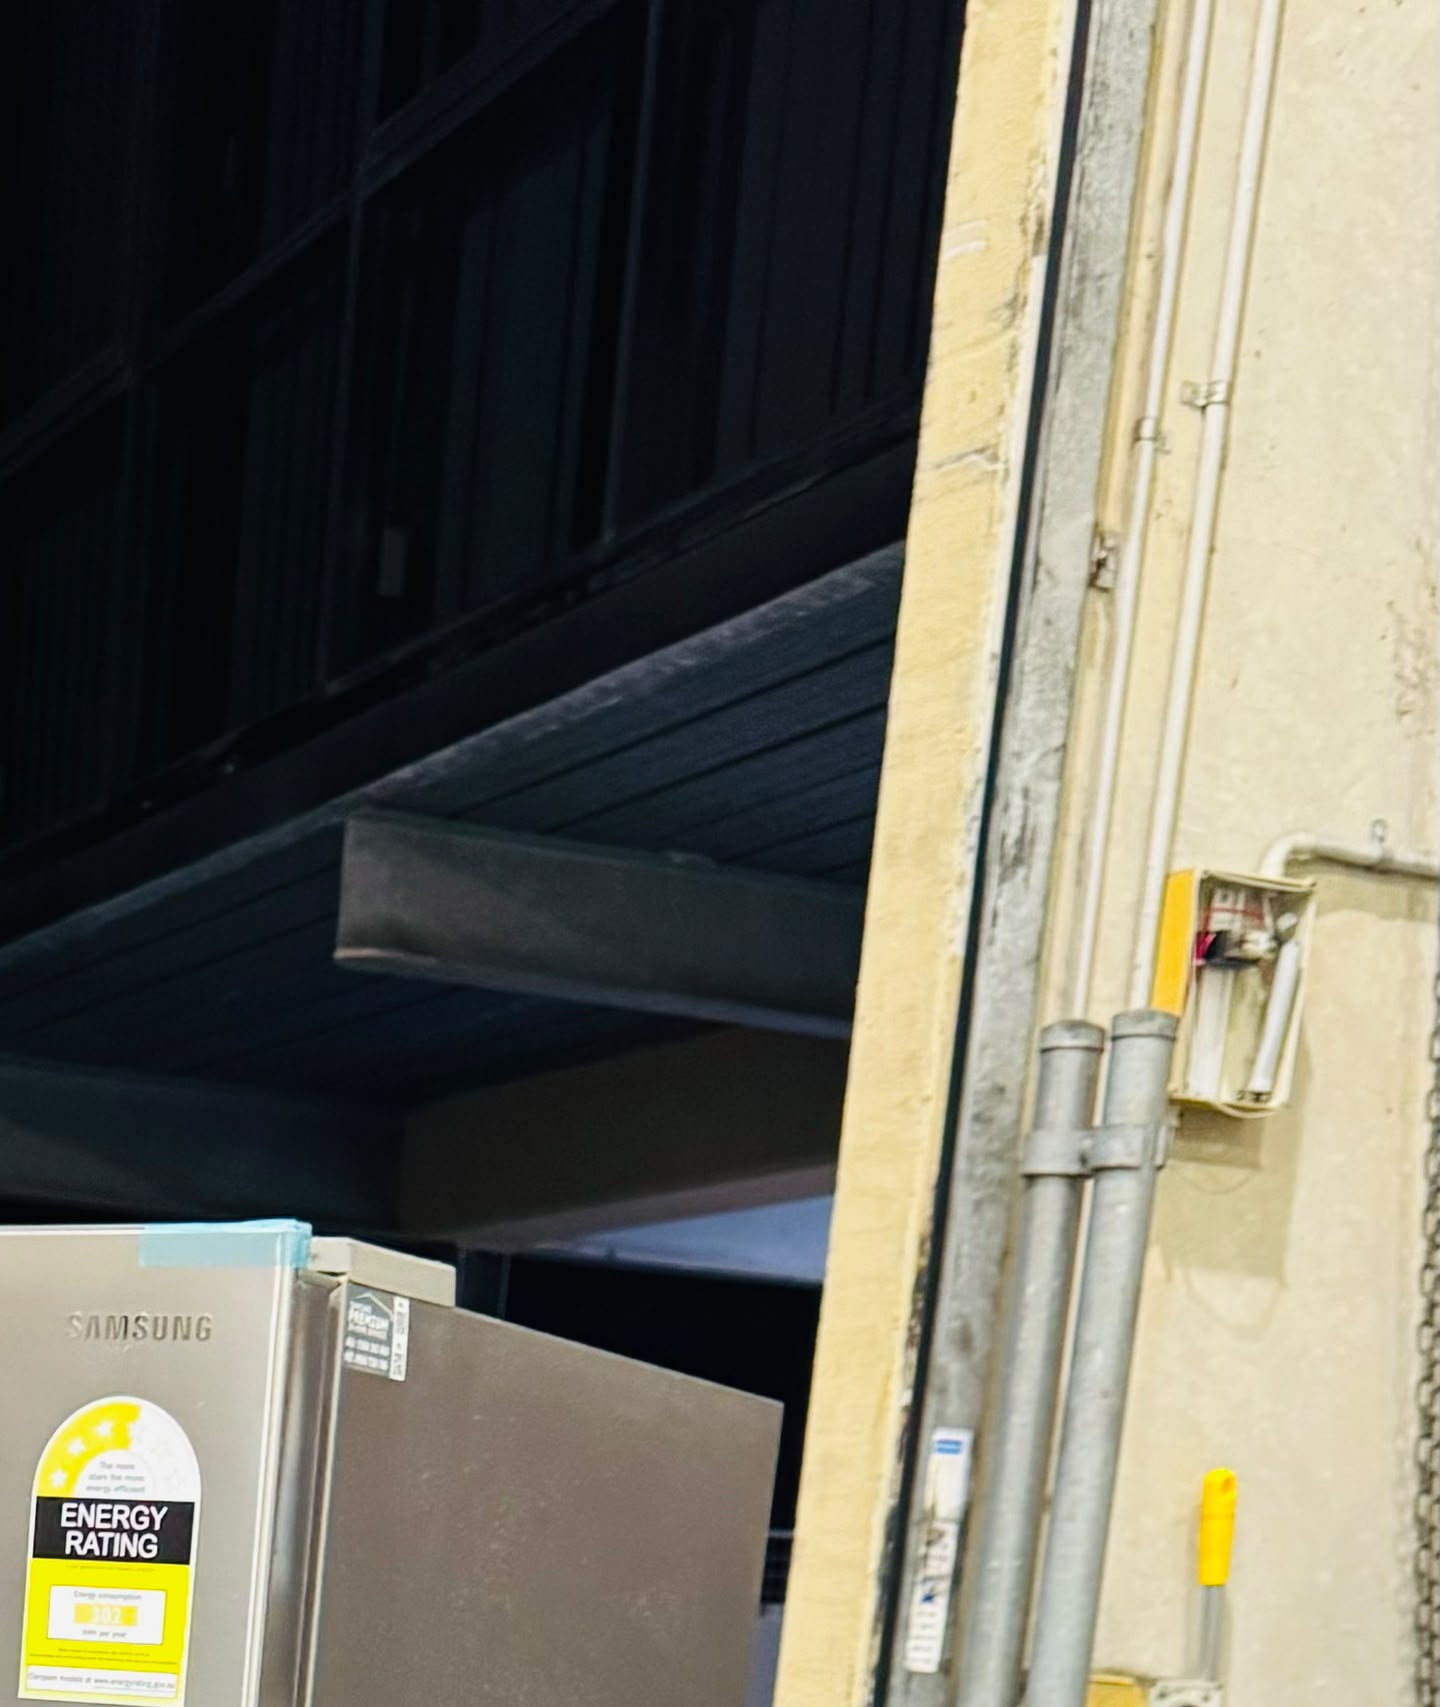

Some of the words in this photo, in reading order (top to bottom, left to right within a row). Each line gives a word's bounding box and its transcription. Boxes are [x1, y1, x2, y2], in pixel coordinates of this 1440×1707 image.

[66, 1312, 212, 1341] SAMSUNG
[61, 1502, 168, 1531] ENERGY
[65, 1530, 158, 1559] RATING
